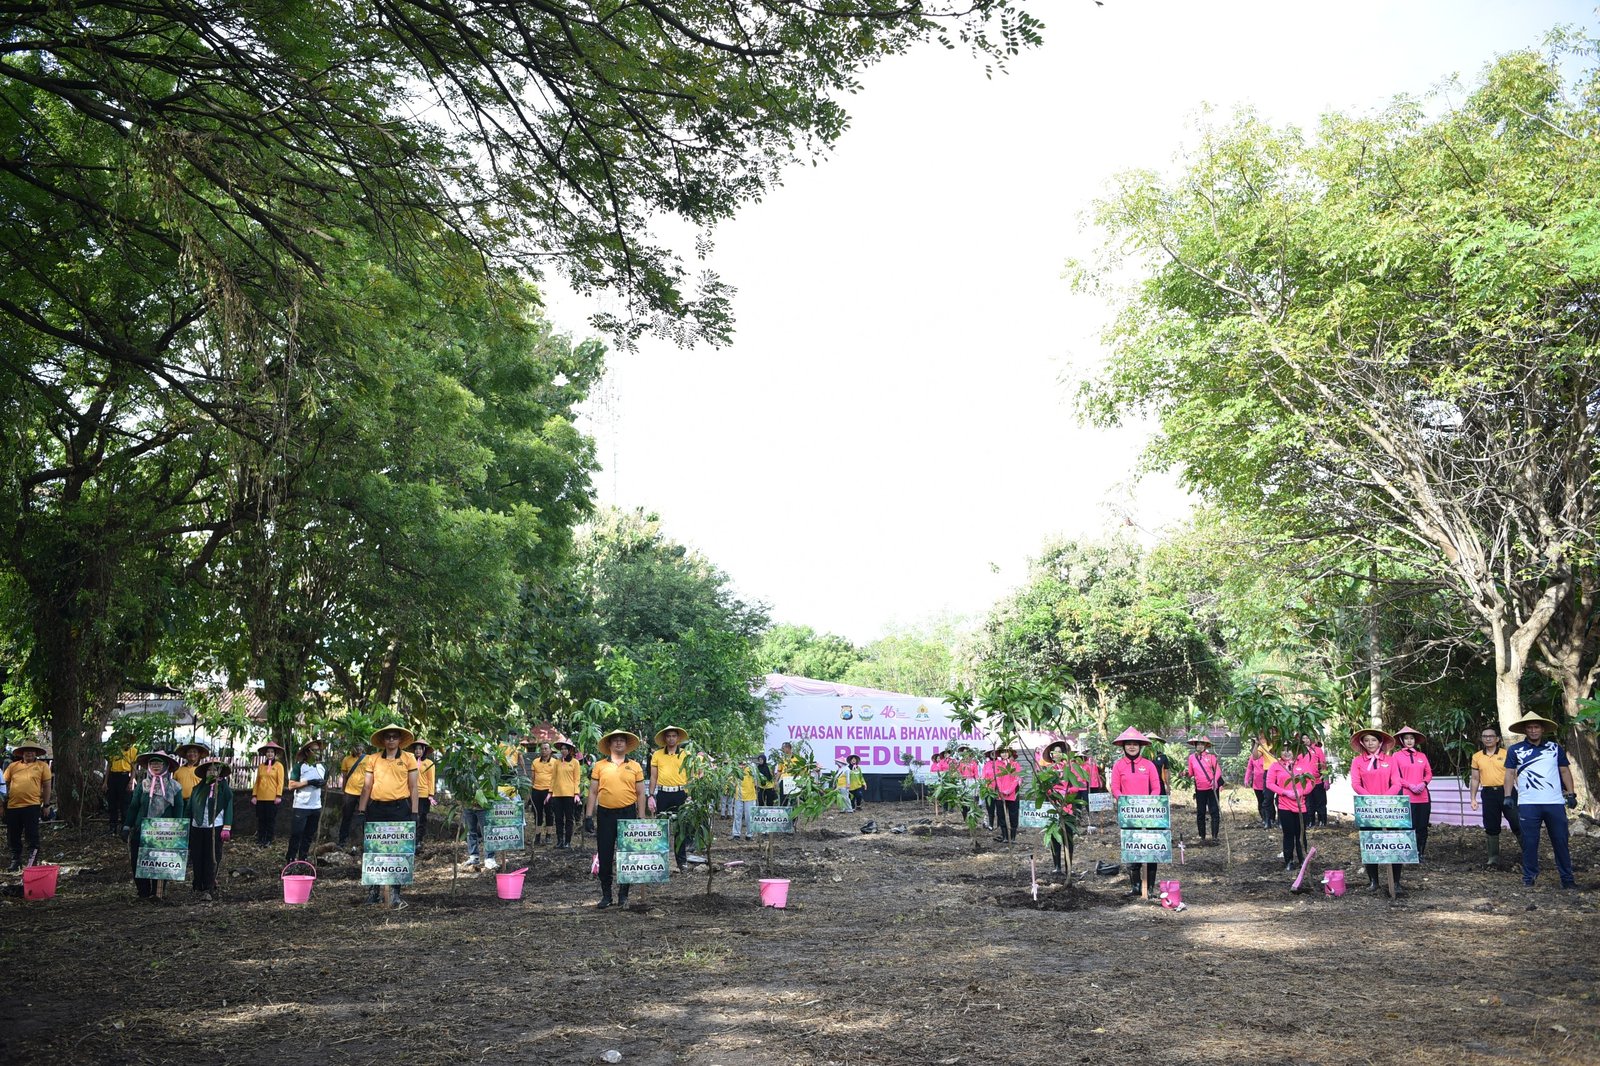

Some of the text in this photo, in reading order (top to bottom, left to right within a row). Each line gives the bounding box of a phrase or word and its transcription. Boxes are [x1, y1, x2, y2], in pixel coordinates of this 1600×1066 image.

[880, 705, 896, 718] 46
[788, 725, 843, 740] YAYASAN
[847, 726, 897, 740] KEMALA
[141, 860, 181, 868] MANGGA
